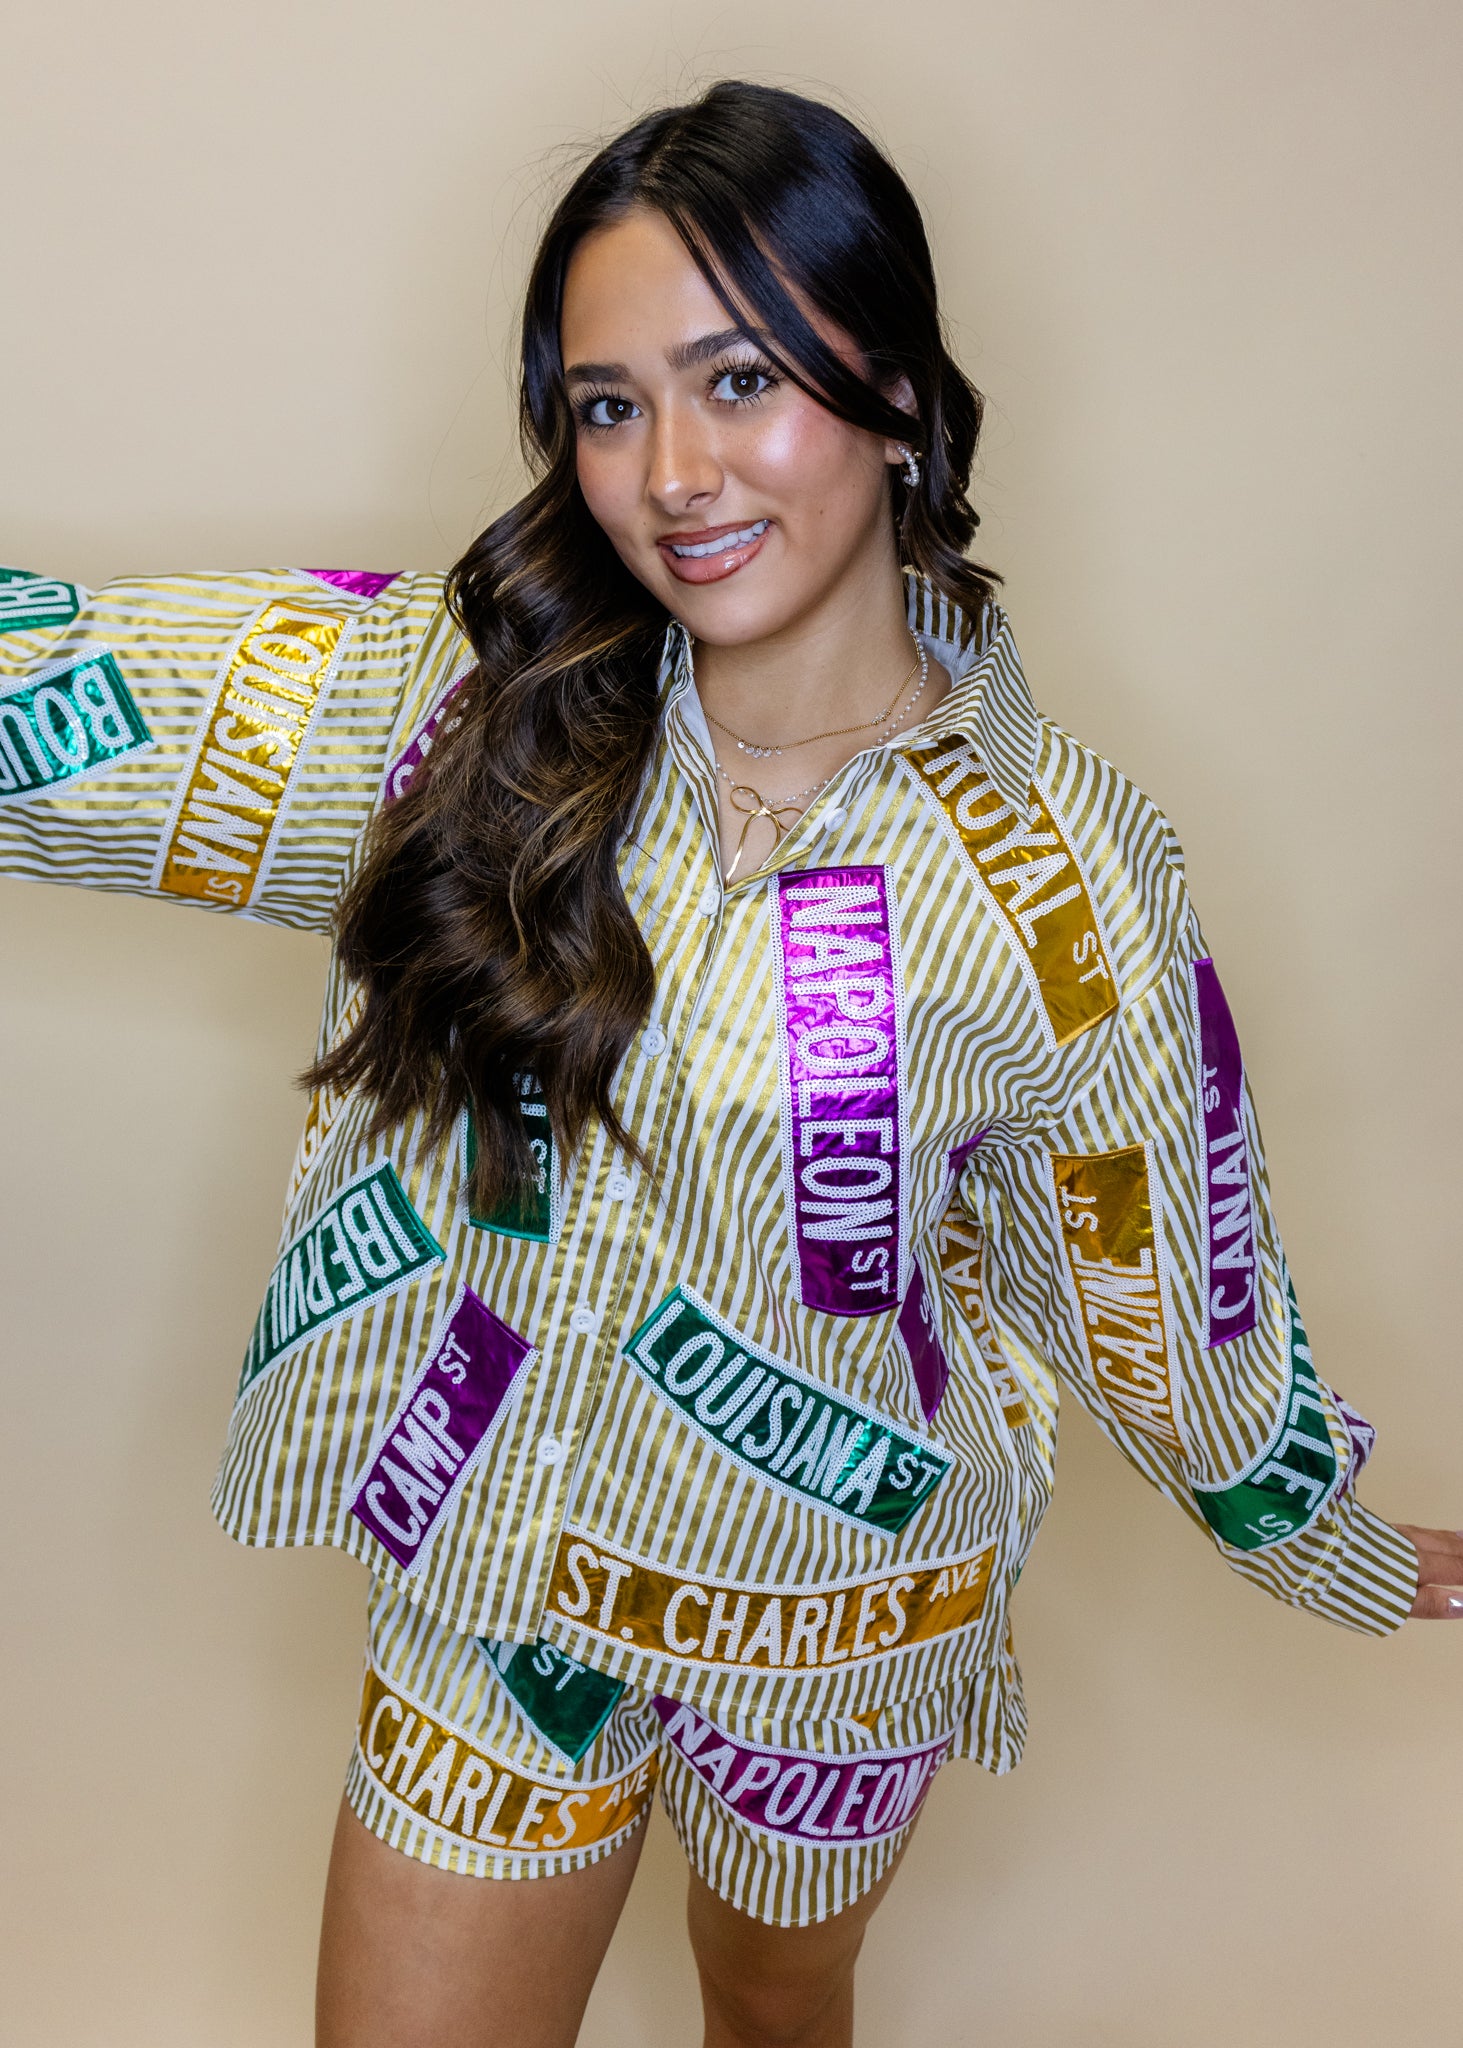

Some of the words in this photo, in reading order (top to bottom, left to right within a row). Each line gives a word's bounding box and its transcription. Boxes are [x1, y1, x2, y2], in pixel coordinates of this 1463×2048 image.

[173, 605, 340, 874] LOUISIANA
[1072, 931, 1109, 984] ST
[785, 884, 893, 1242] NAPOLEON
[850, 1246, 890, 1295] ST
[1201, 1063, 1221, 1114] ST
[1058, 1185, 1099, 1233] ST
[1209, 1107, 1255, 1321] CANAL
[634, 1300, 892, 1515] LOUISIANA
[889, 1457, 942, 1497] ST
[1070, 1243, 1180, 1449] MAGAZINE
[365, 1388, 466, 1547] CAMP
[436, 1332, 472, 1385] ST
[1244, 1513, 1295, 1542] ST
[532, 1643, 586, 1692] ST
[557, 1543, 634, 1640] ST.
[663, 1577, 916, 1667] CHARLES
[929, 1560, 981, 1603] AVE
[366, 1694, 591, 1850] CHARLES
[600, 1762, 651, 1812] AVE
[665, 1704, 935, 1836] NAPOLEON
